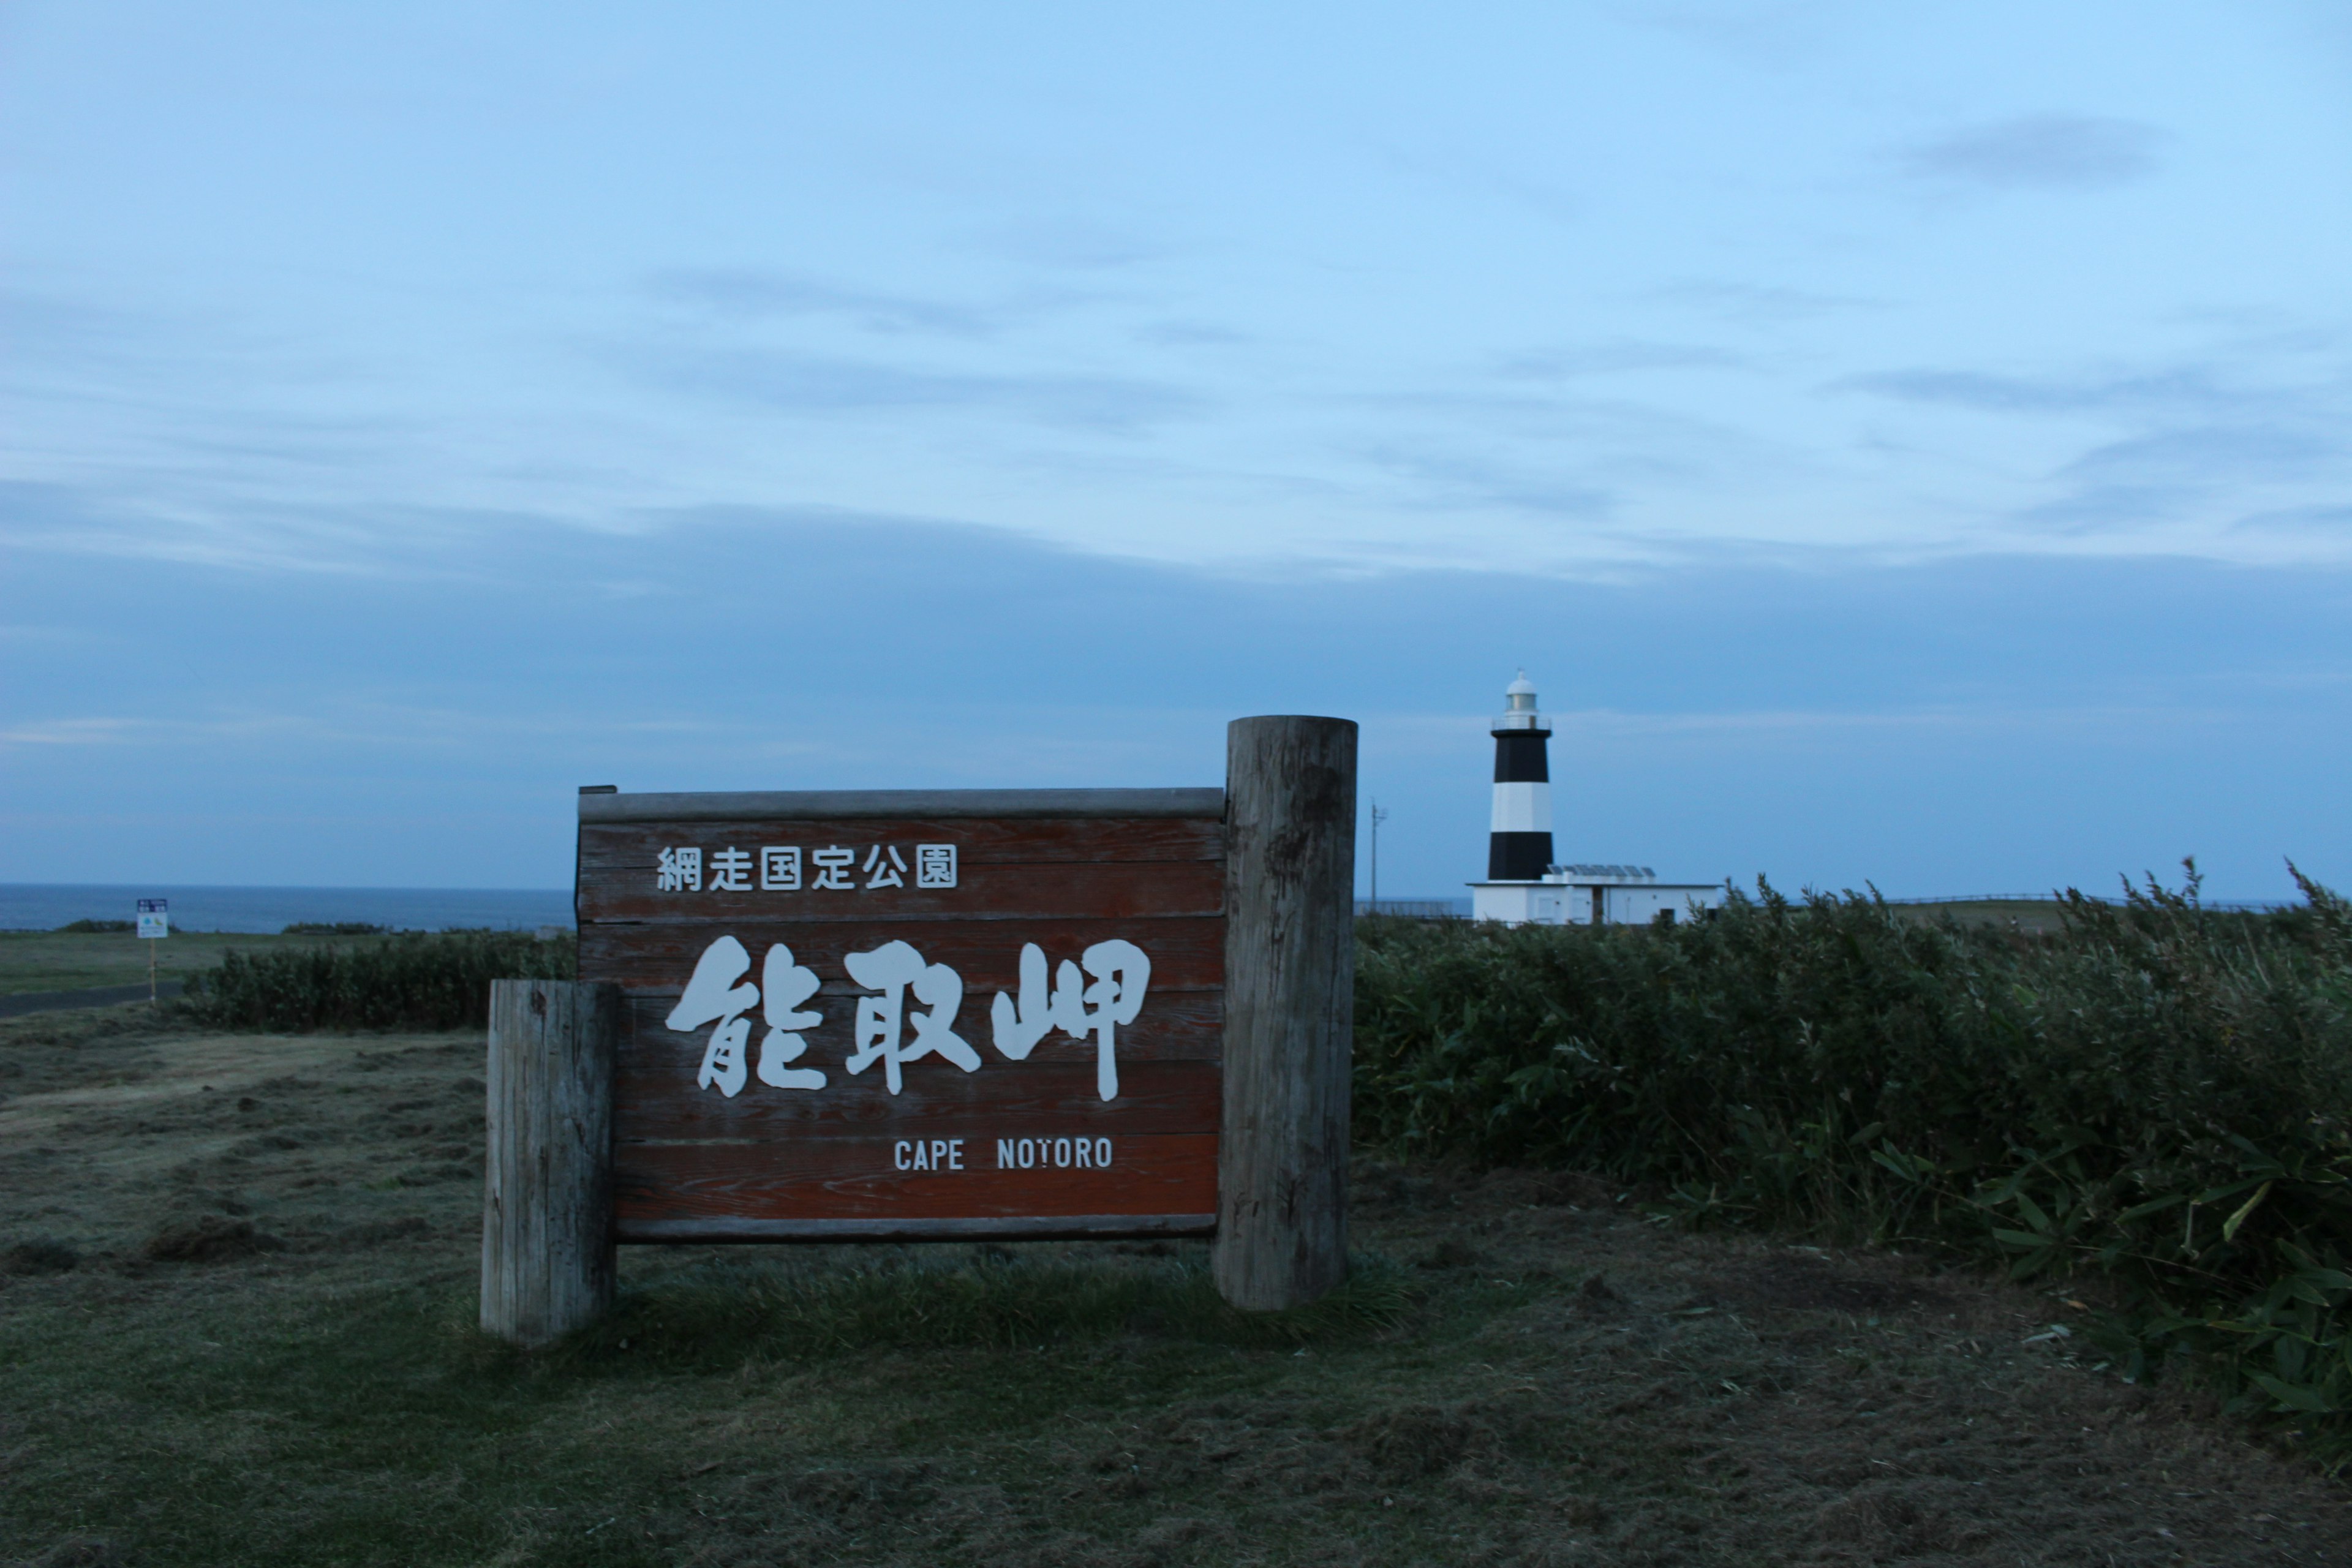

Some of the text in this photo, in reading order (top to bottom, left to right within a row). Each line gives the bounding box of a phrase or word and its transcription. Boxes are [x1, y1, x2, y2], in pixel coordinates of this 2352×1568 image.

[656, 843, 957, 892] 網走国定公園
[665, 935, 1151, 1102] 能取岬
[894, 1137, 1112, 1170] CAPE NOTORO
